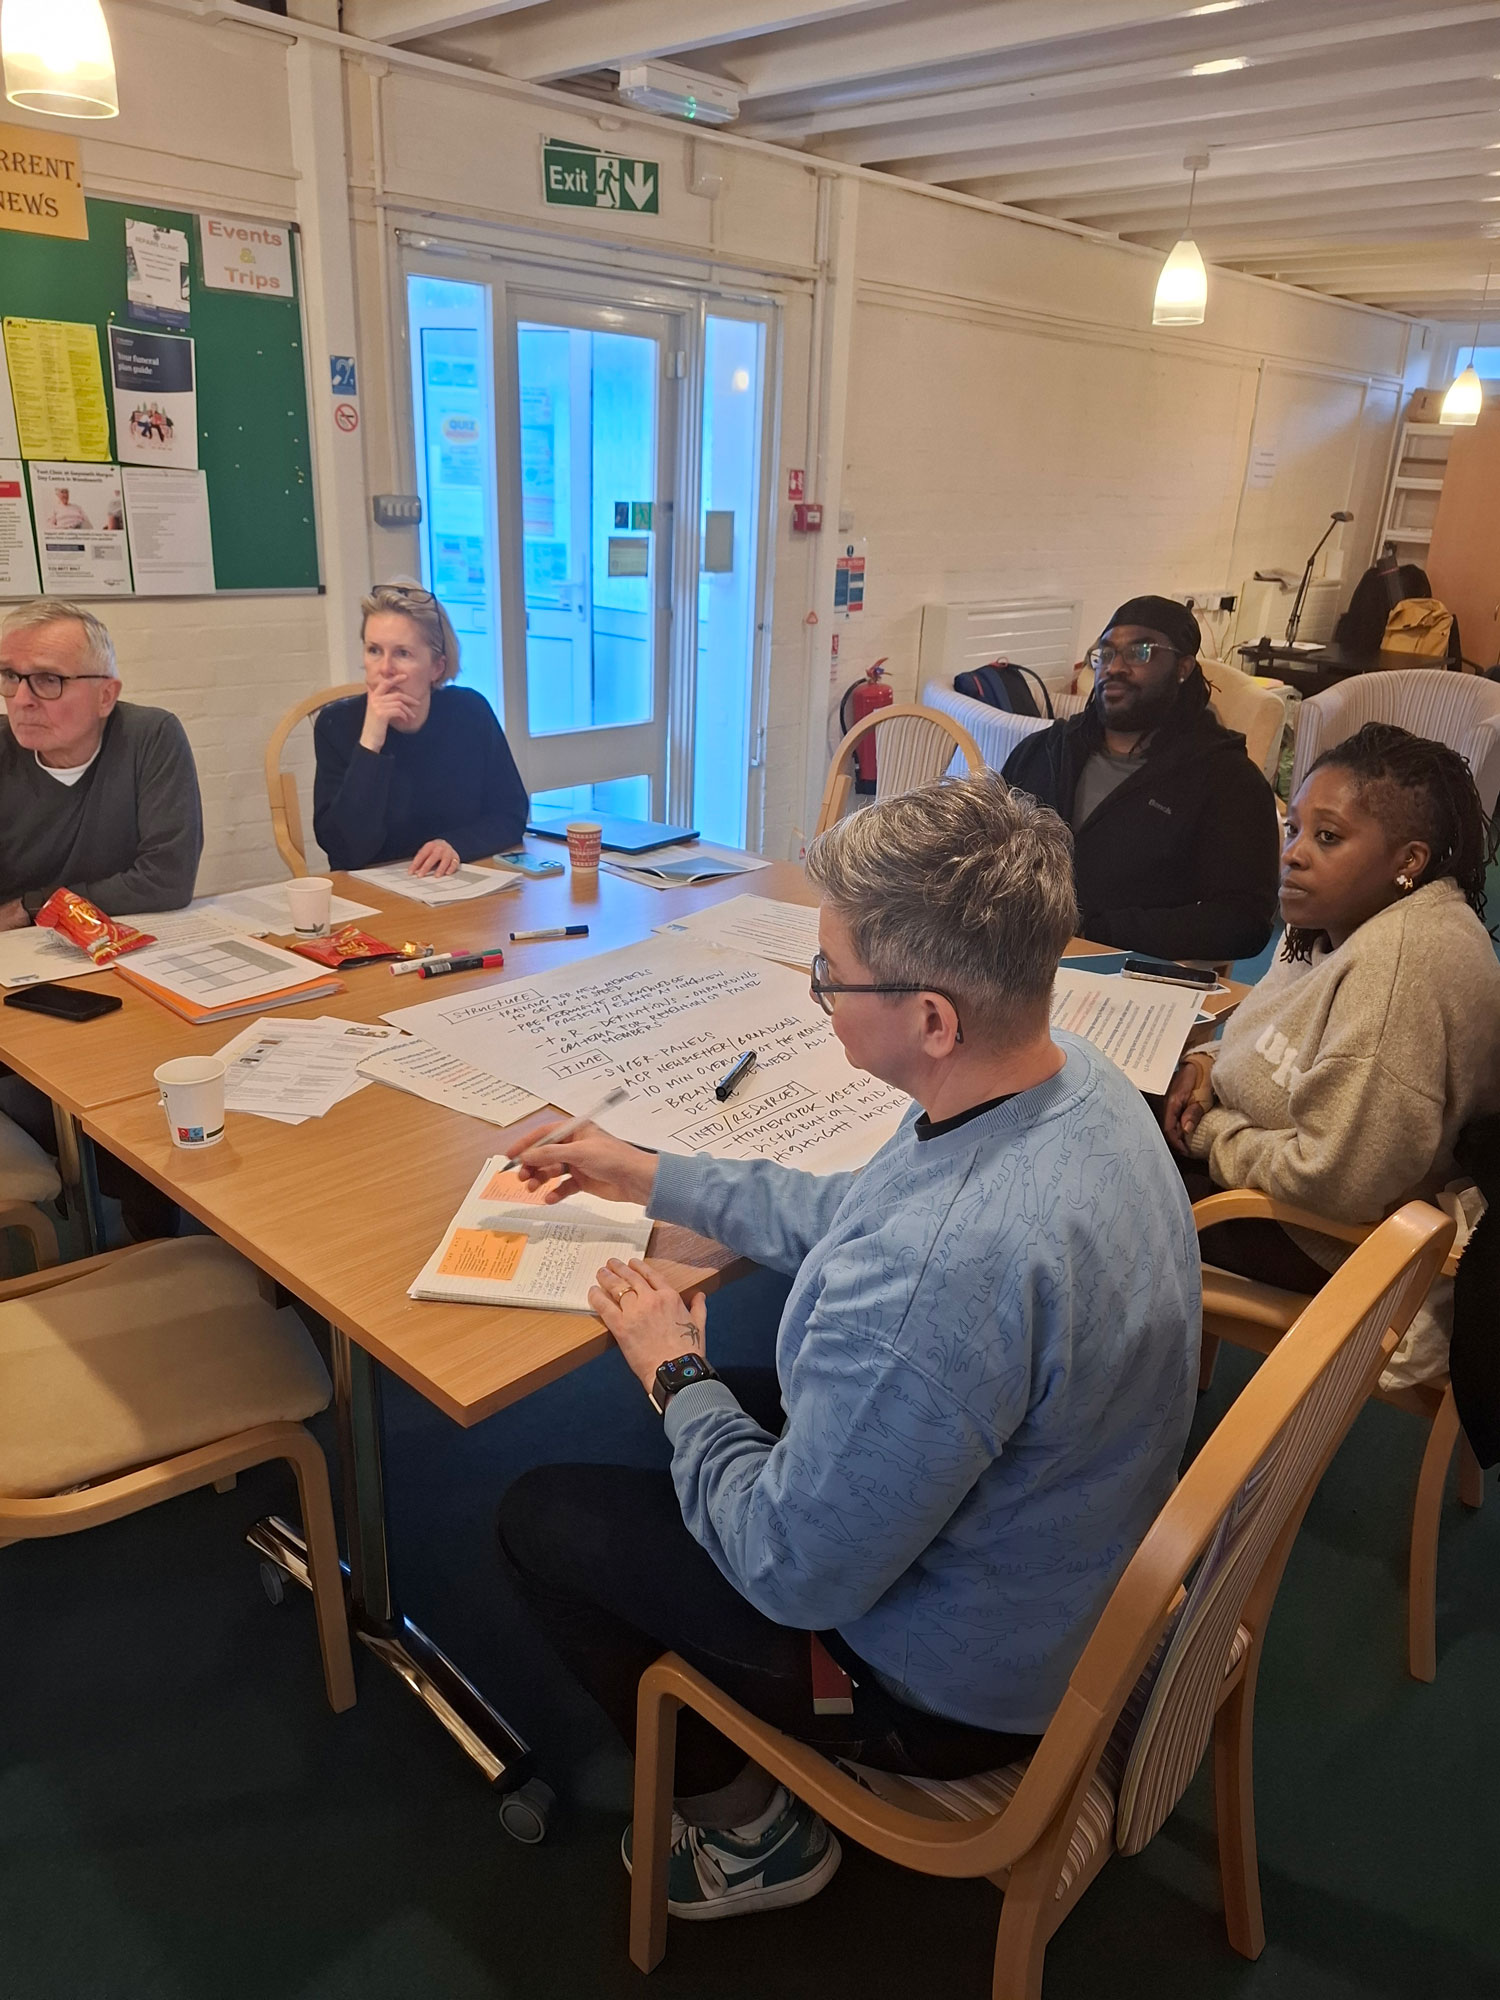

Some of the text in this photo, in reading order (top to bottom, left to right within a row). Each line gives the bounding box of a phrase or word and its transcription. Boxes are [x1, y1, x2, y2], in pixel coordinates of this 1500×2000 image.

[549, 165, 589, 193] Exit
[208, 220, 282, 246] Events
[240, 247, 256, 264] &
[223, 266, 281, 289] Trips
[133, 354, 159, 366] funeral
[133, 366, 153, 375] guide
[449, 420, 476, 431] QUIZ
[532, 1004, 552, 1014] GET
[805, 1038, 827, 1050] ALL
[559, 1054, 603, 1076] TIME
[697, 1045, 757, 1075] OVERVIE
[624, 1070, 652, 1088] ACP
[732, 1076, 873, 1146] HOMEWORK USEFUL
